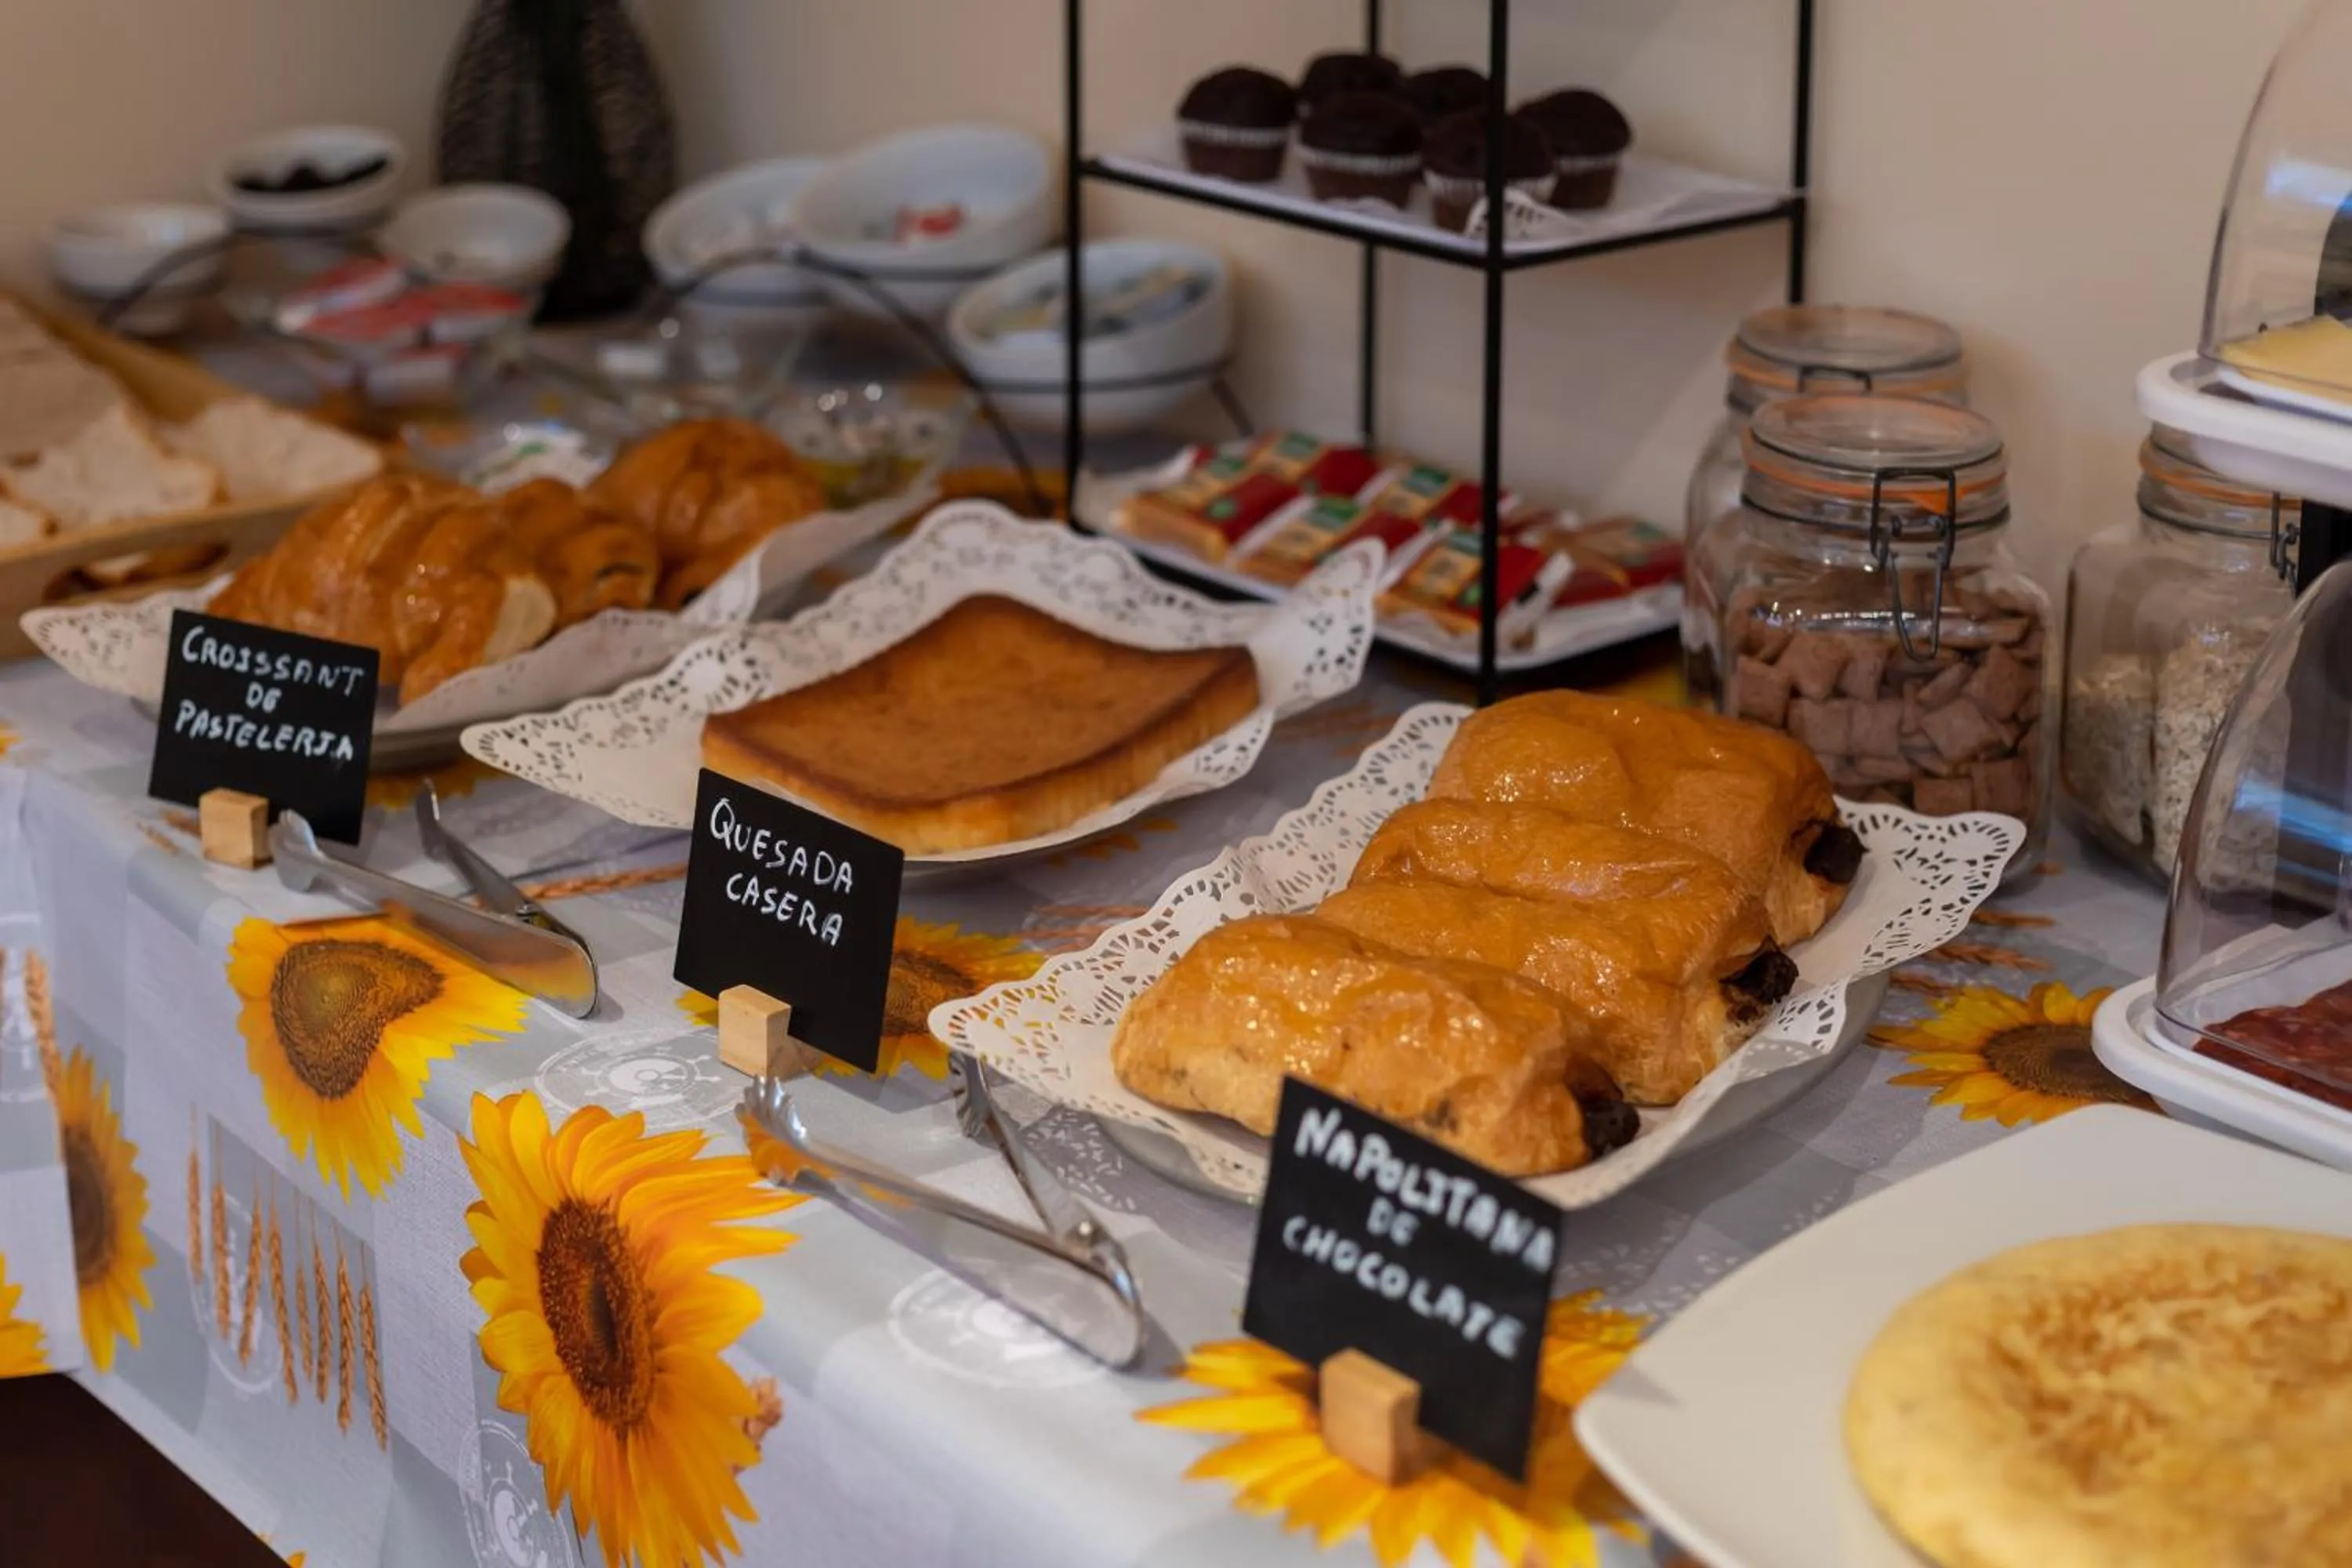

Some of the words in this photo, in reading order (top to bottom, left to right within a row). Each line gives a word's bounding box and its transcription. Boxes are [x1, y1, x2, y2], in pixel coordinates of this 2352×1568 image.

[181, 626, 364, 695] CROISSANT
[175, 699, 354, 760] PASTELERIA
[245, 681, 282, 713] DE
[710, 797, 853, 894] QUESADA
[726, 873, 843, 946] CASERA
[1294, 1109, 1555, 1272] NAPOLITANA
[1367, 1196, 1418, 1246] DE
[1283, 1215, 1524, 1359] CHOCOLATE
